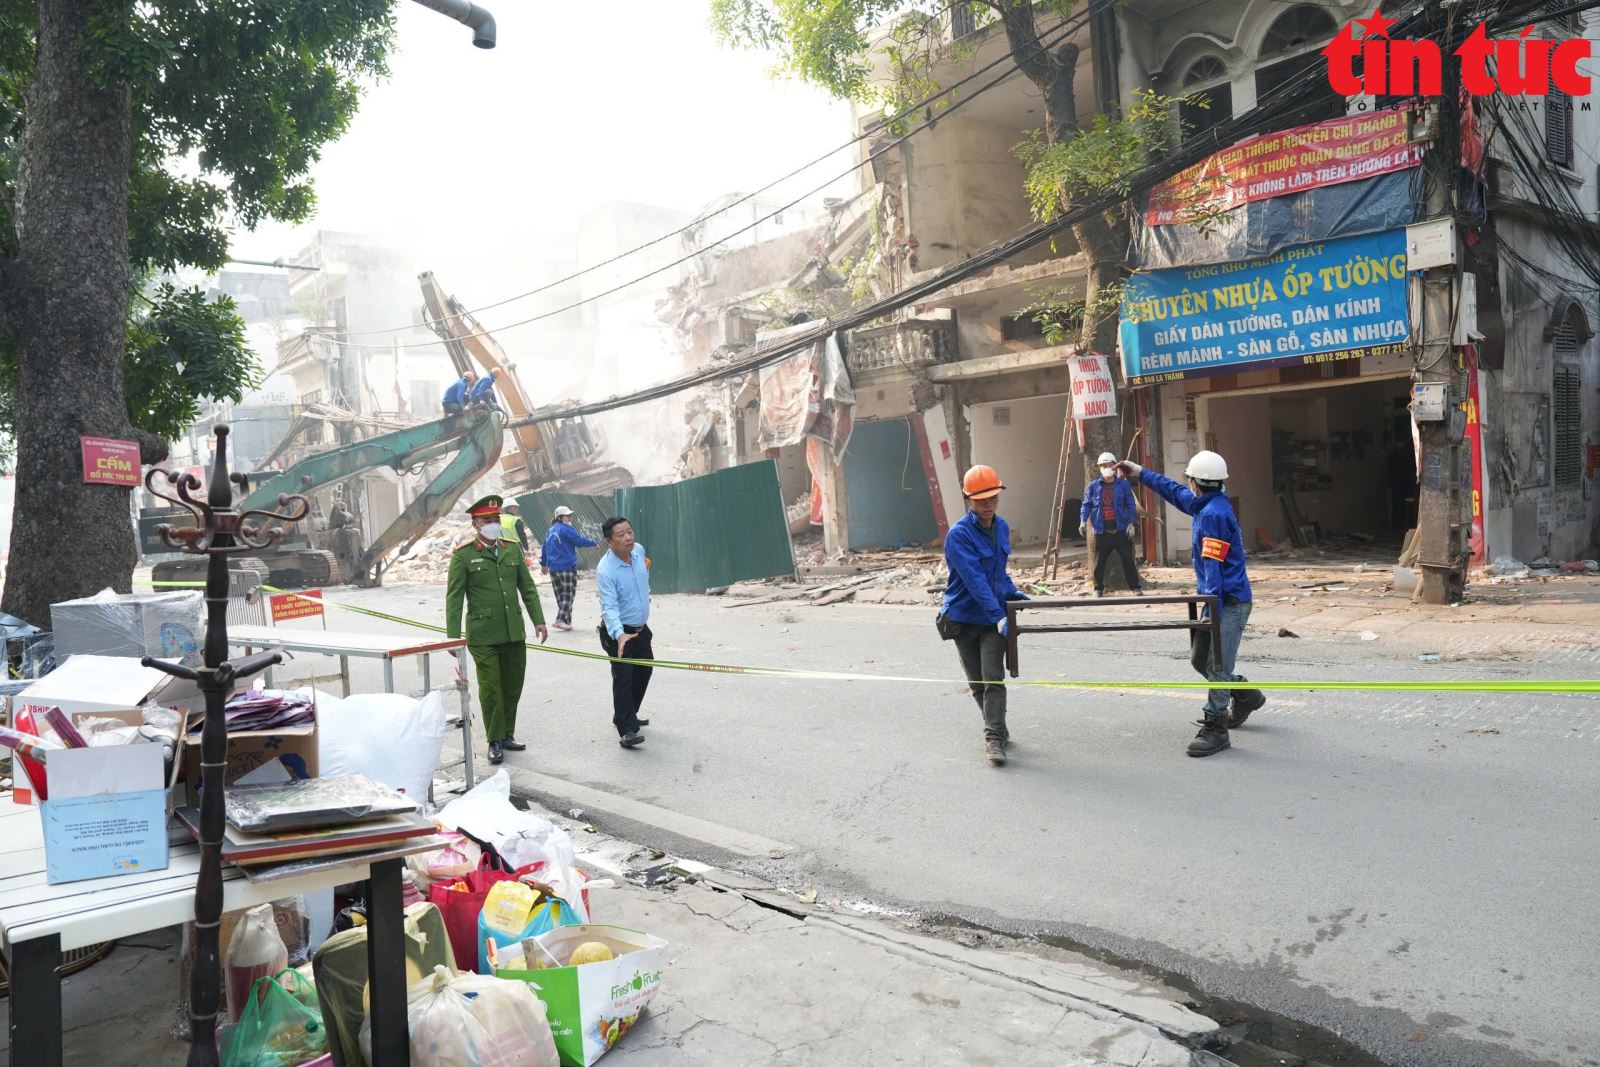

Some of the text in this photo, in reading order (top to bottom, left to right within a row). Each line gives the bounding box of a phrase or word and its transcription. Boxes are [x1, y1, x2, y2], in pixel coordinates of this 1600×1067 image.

[1248, 178, 1286, 196] KHÔNG
[1288, 171, 1313, 188] LÀM
[1316, 163, 1346, 183] TRÊN
[1221, 260, 1248, 275] KHO
[1128, 254, 1407, 325] CHUYÊN NHỰA ỐP TƯỜNG
[1154, 296, 1381, 346] GIẤY DÁN TƯỜNG, DÁN KÍNH
[1141, 352, 1173, 371] RÈM
[1177, 346, 1223, 366] MÀNH
[1238, 338, 1273, 358] SÀN
[1310, 327, 1348, 348] SÀN
[1352, 318, 1408, 342] NHỰA
[1315, 350, 1334, 363] 0912
[1087, 374, 1113, 394] TƯỜNG
[1084, 400, 1108, 416] NANO
[96, 455, 132, 471] CẤM
[611, 980, 632, 1000] Fresh
